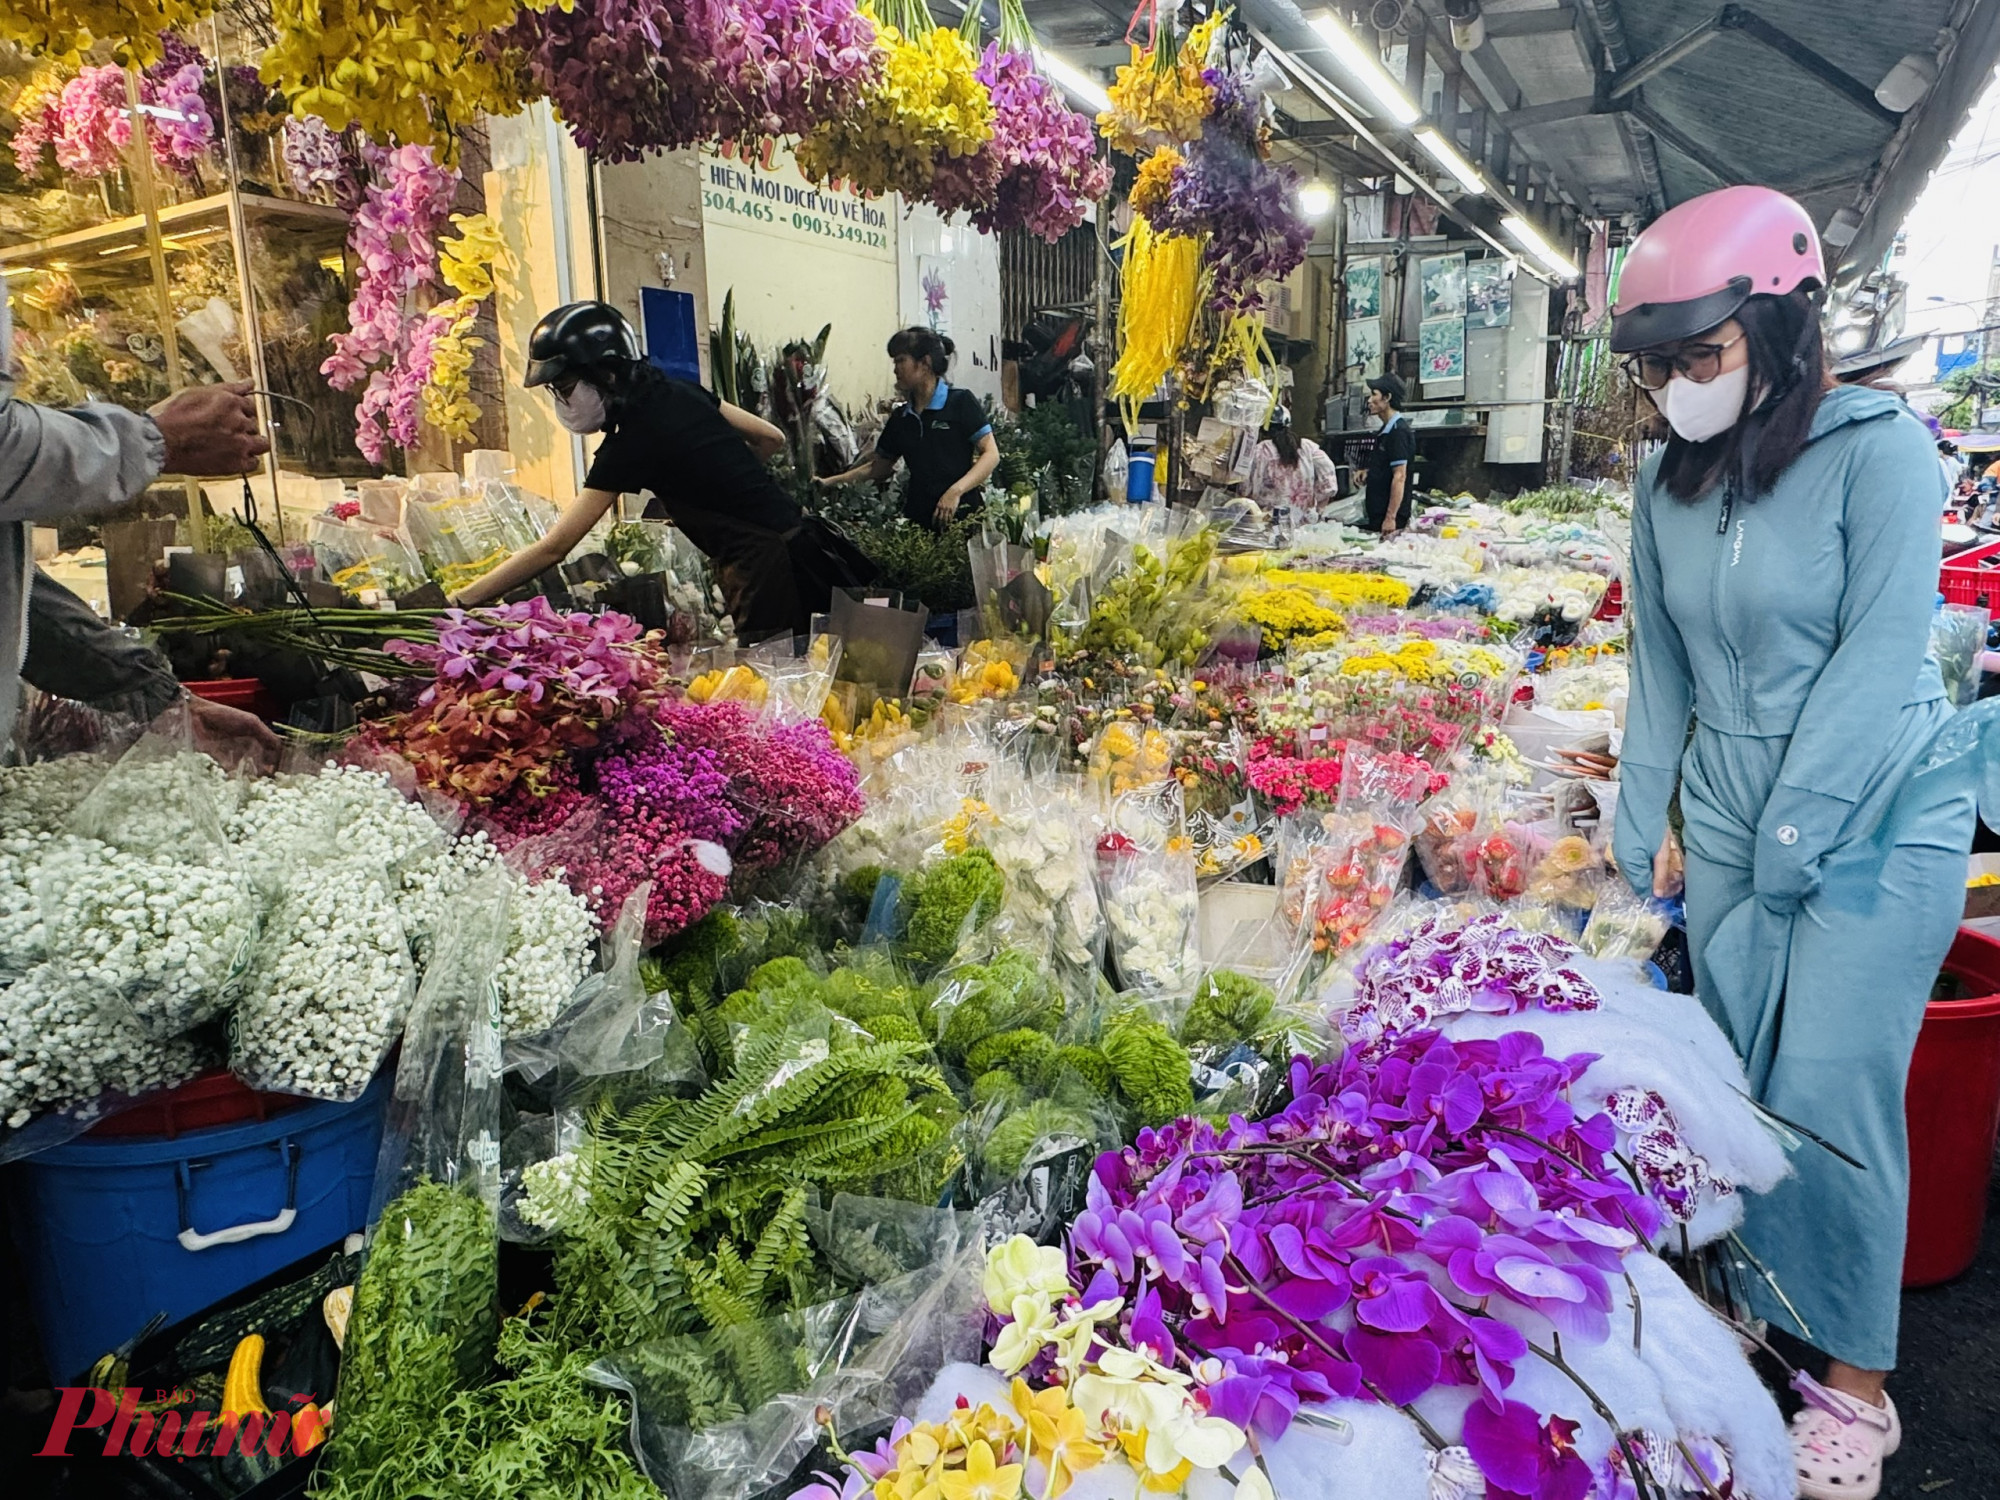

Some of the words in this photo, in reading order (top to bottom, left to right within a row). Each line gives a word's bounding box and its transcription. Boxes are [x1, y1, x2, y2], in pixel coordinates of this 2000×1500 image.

[710, 165, 747, 194] HIỆN
[751, 175, 781, 204] MỌI
[784, 185, 815, 211] DỊCH
[820, 195, 838, 220] VỤ
[863, 205, 887, 229] HOA
[792, 212, 887, 250] 0903.349.124
